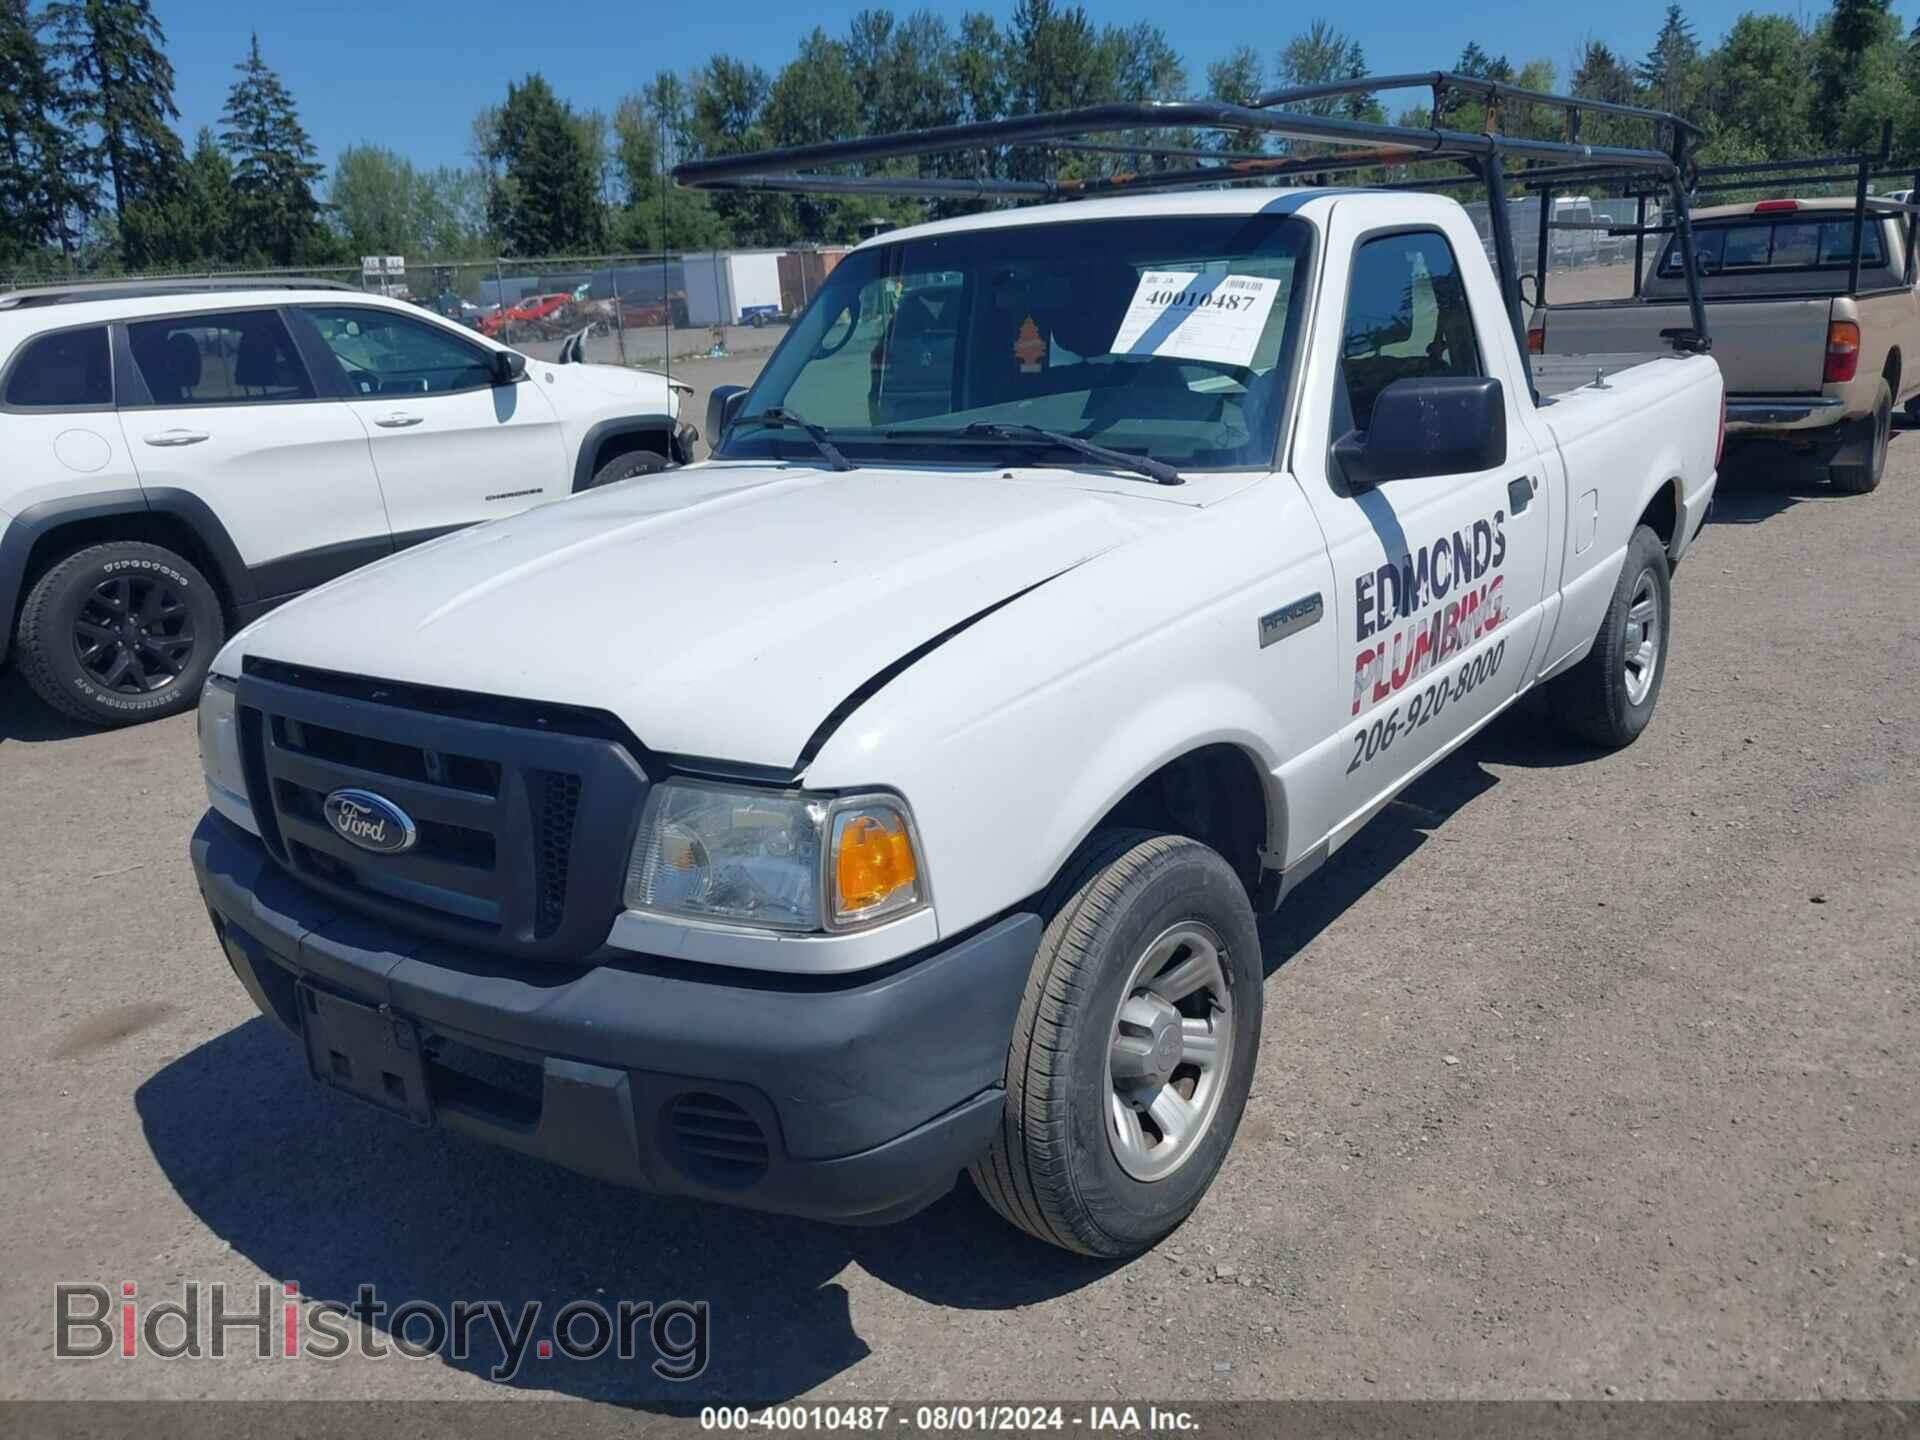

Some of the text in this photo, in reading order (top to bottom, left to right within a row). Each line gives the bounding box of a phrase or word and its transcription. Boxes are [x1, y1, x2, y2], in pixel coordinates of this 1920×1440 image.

[1145, 289, 1255, 311] 40010487
[485, 488, 543, 500] CHEROKEE
[1355, 510, 1506, 643] EDMONDS
[1264, 595, 1324, 633] RANGER
[1351, 574, 1505, 717] PLUMBING
[1345, 638, 1505, 776] 206-920-8000
[338, 800, 386, 842] Ford
